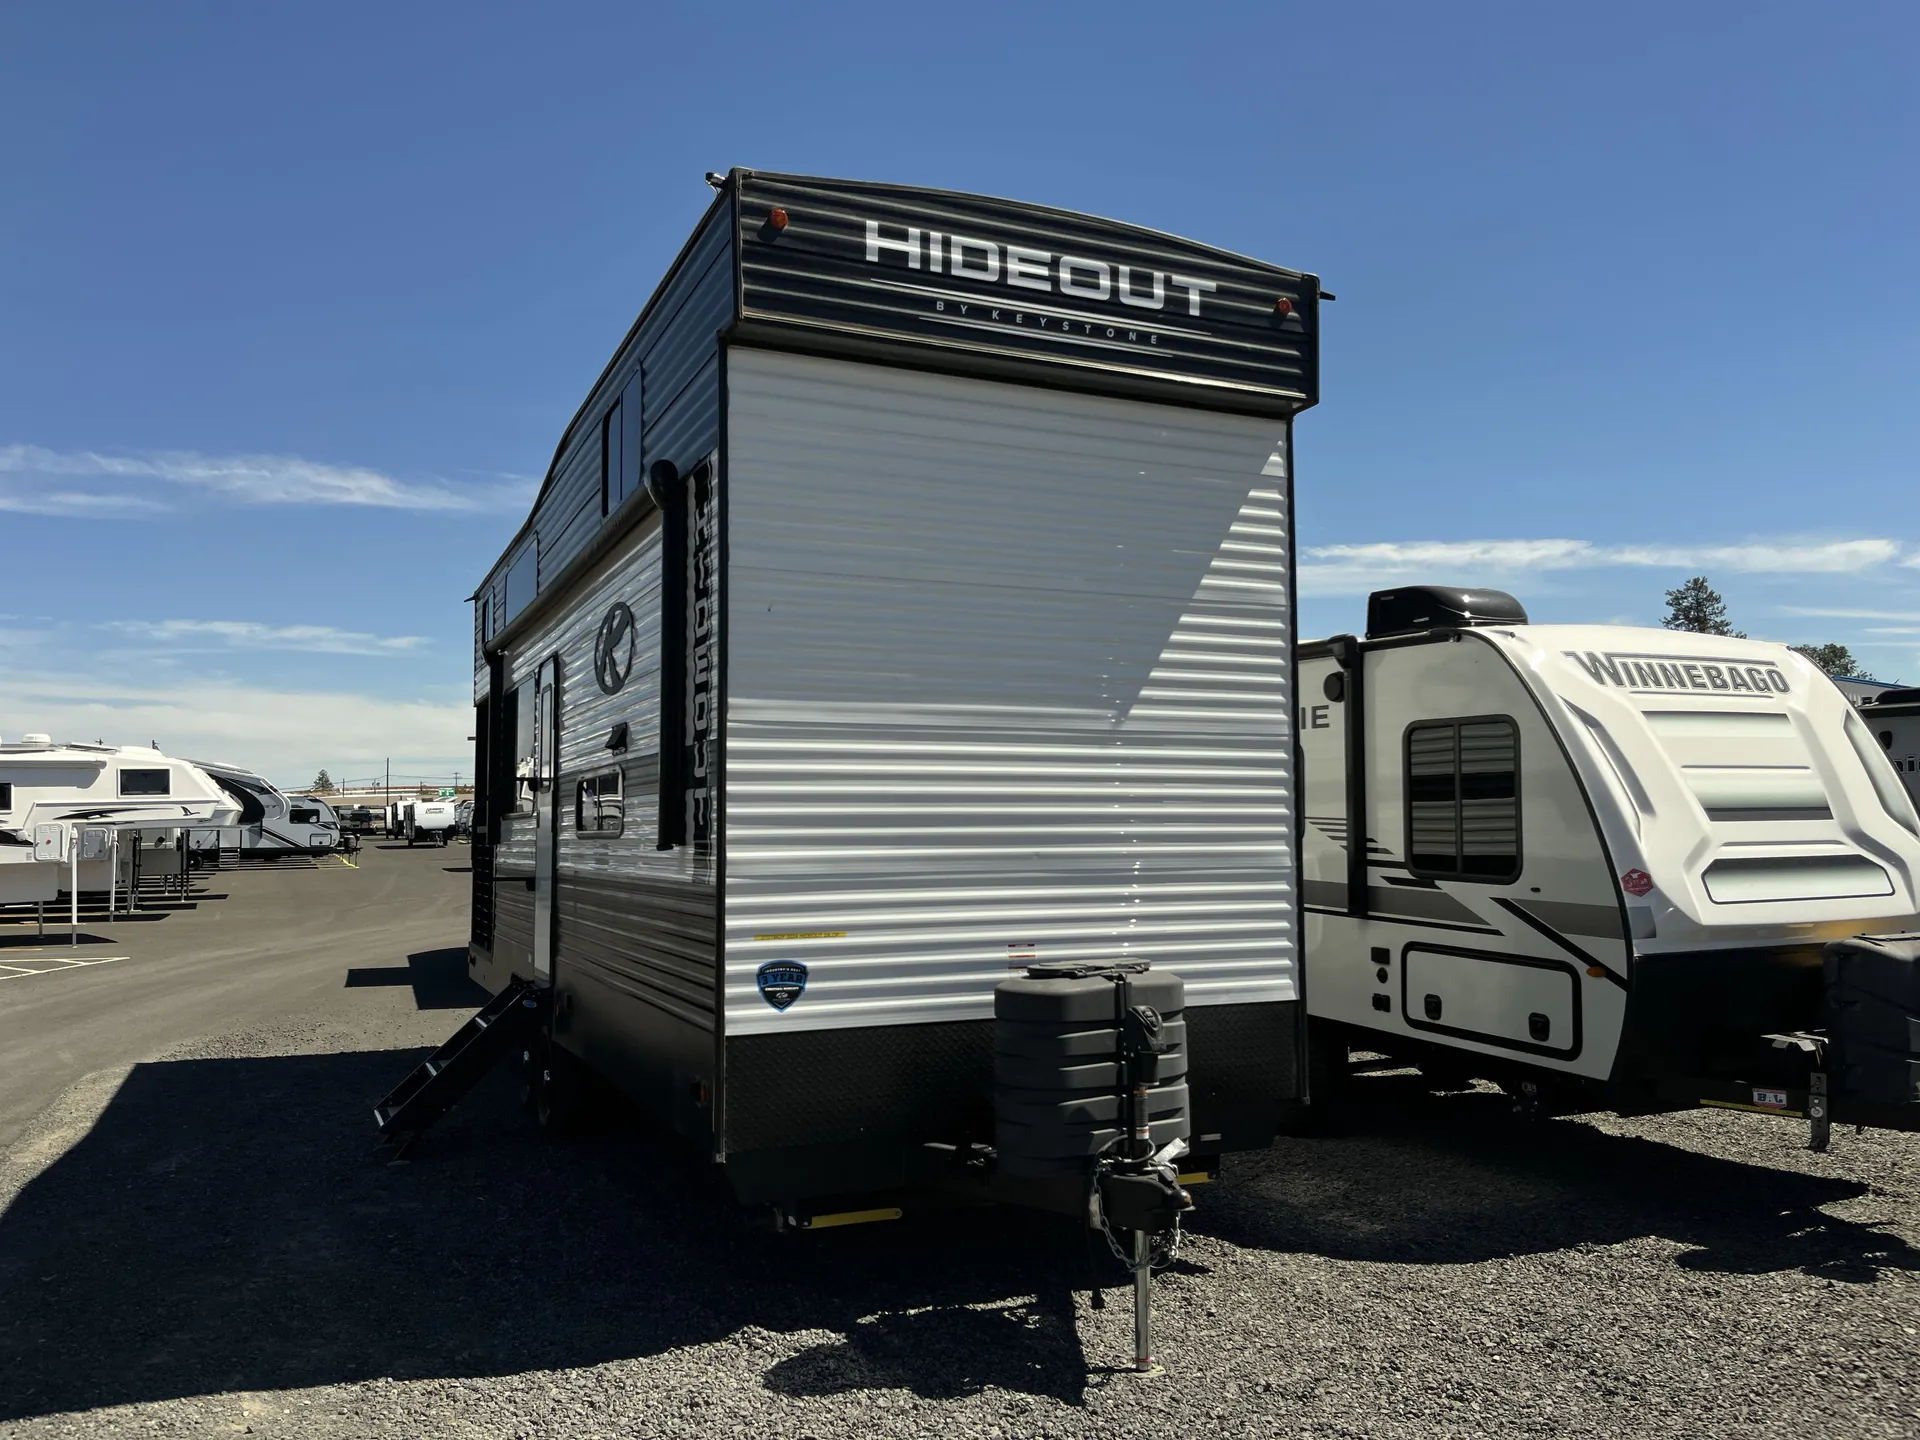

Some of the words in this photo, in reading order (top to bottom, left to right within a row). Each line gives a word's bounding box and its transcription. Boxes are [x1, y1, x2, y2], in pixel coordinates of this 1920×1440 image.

[865, 220, 1217, 316] HIDEOUT
[936, 301, 968, 315] BY
[991, 310, 1158, 345] KEYSTONE
[694, 501, 711, 826] HIDEOUT
[1563, 651, 1792, 694] WINNEBAGO
[762, 975, 768, 985] 3
[772, 973, 803, 985] YEAR
